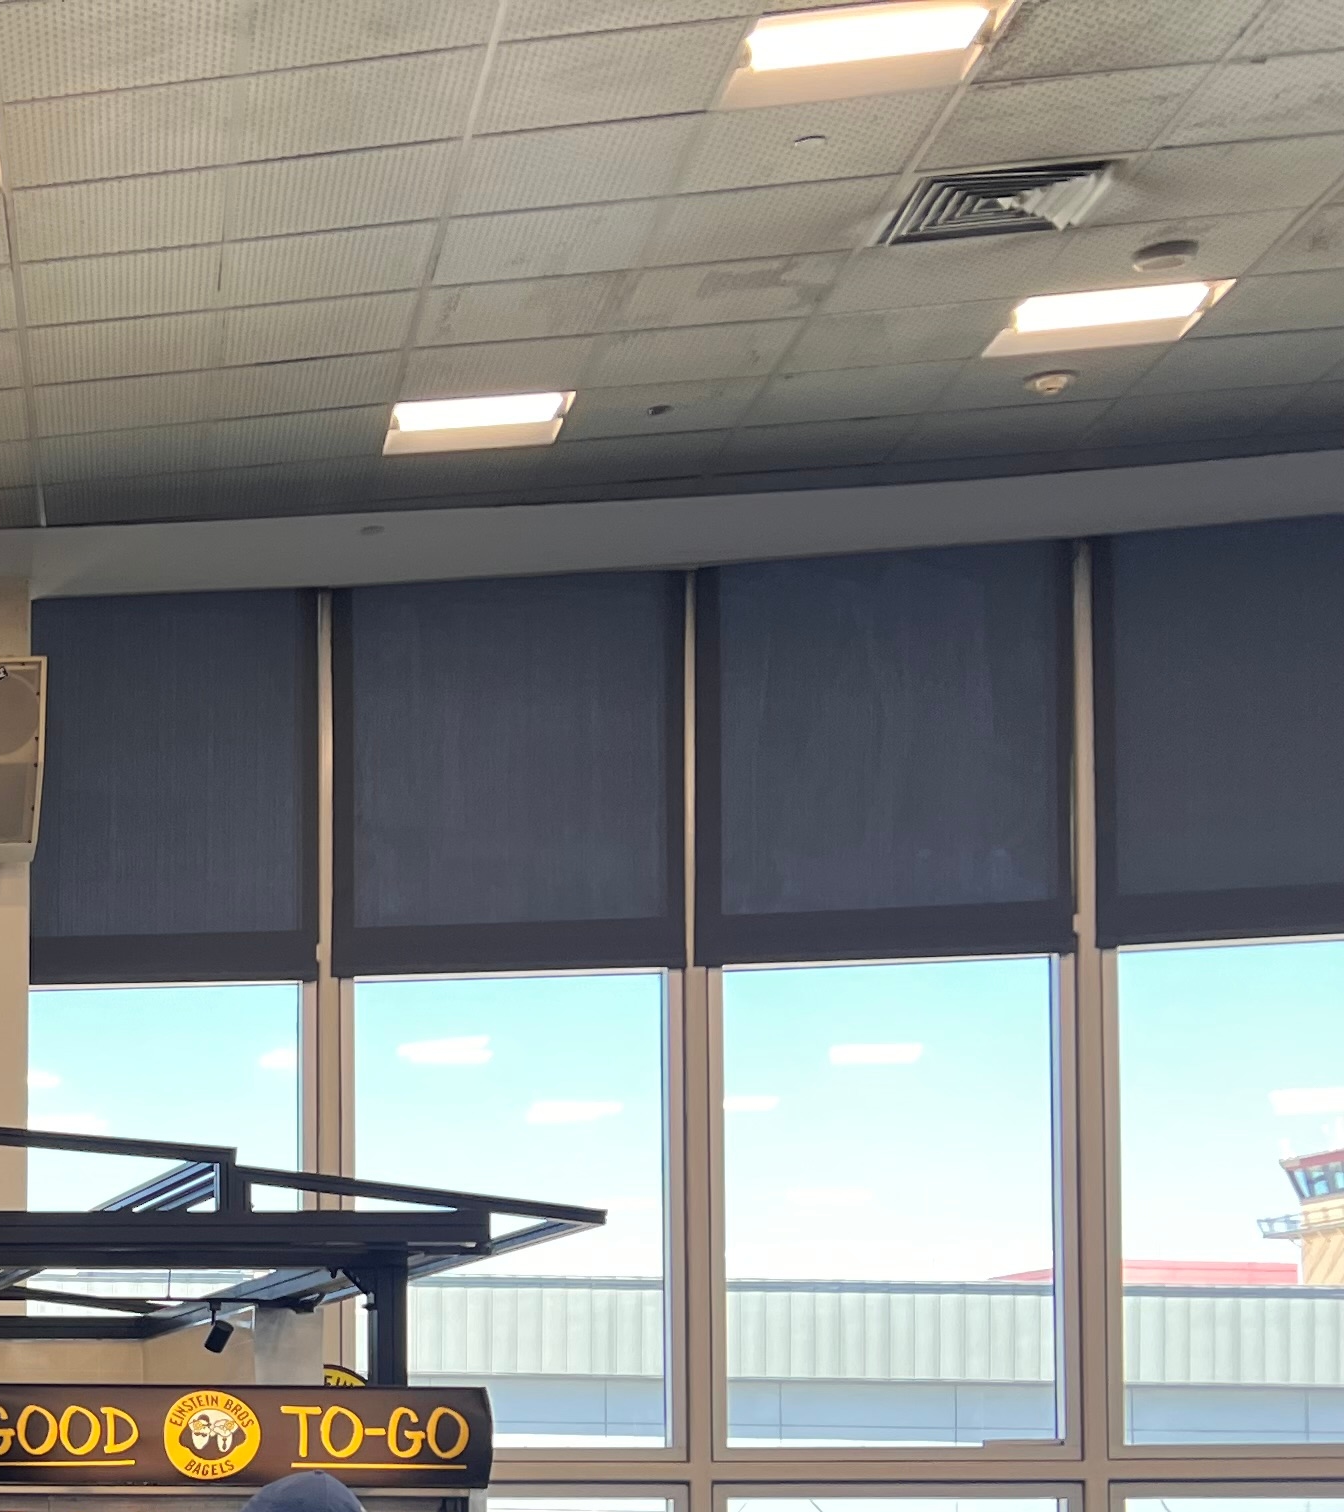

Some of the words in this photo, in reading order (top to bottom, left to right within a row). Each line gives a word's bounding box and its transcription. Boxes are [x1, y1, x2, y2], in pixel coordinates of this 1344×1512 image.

[169, 1394, 219, 1427] EINSTEIN
[223, 1398, 255, 1429] BROS
[281, 1405, 469, 1460] TO-GO
[184, 1459, 235, 1476] BAGELS
